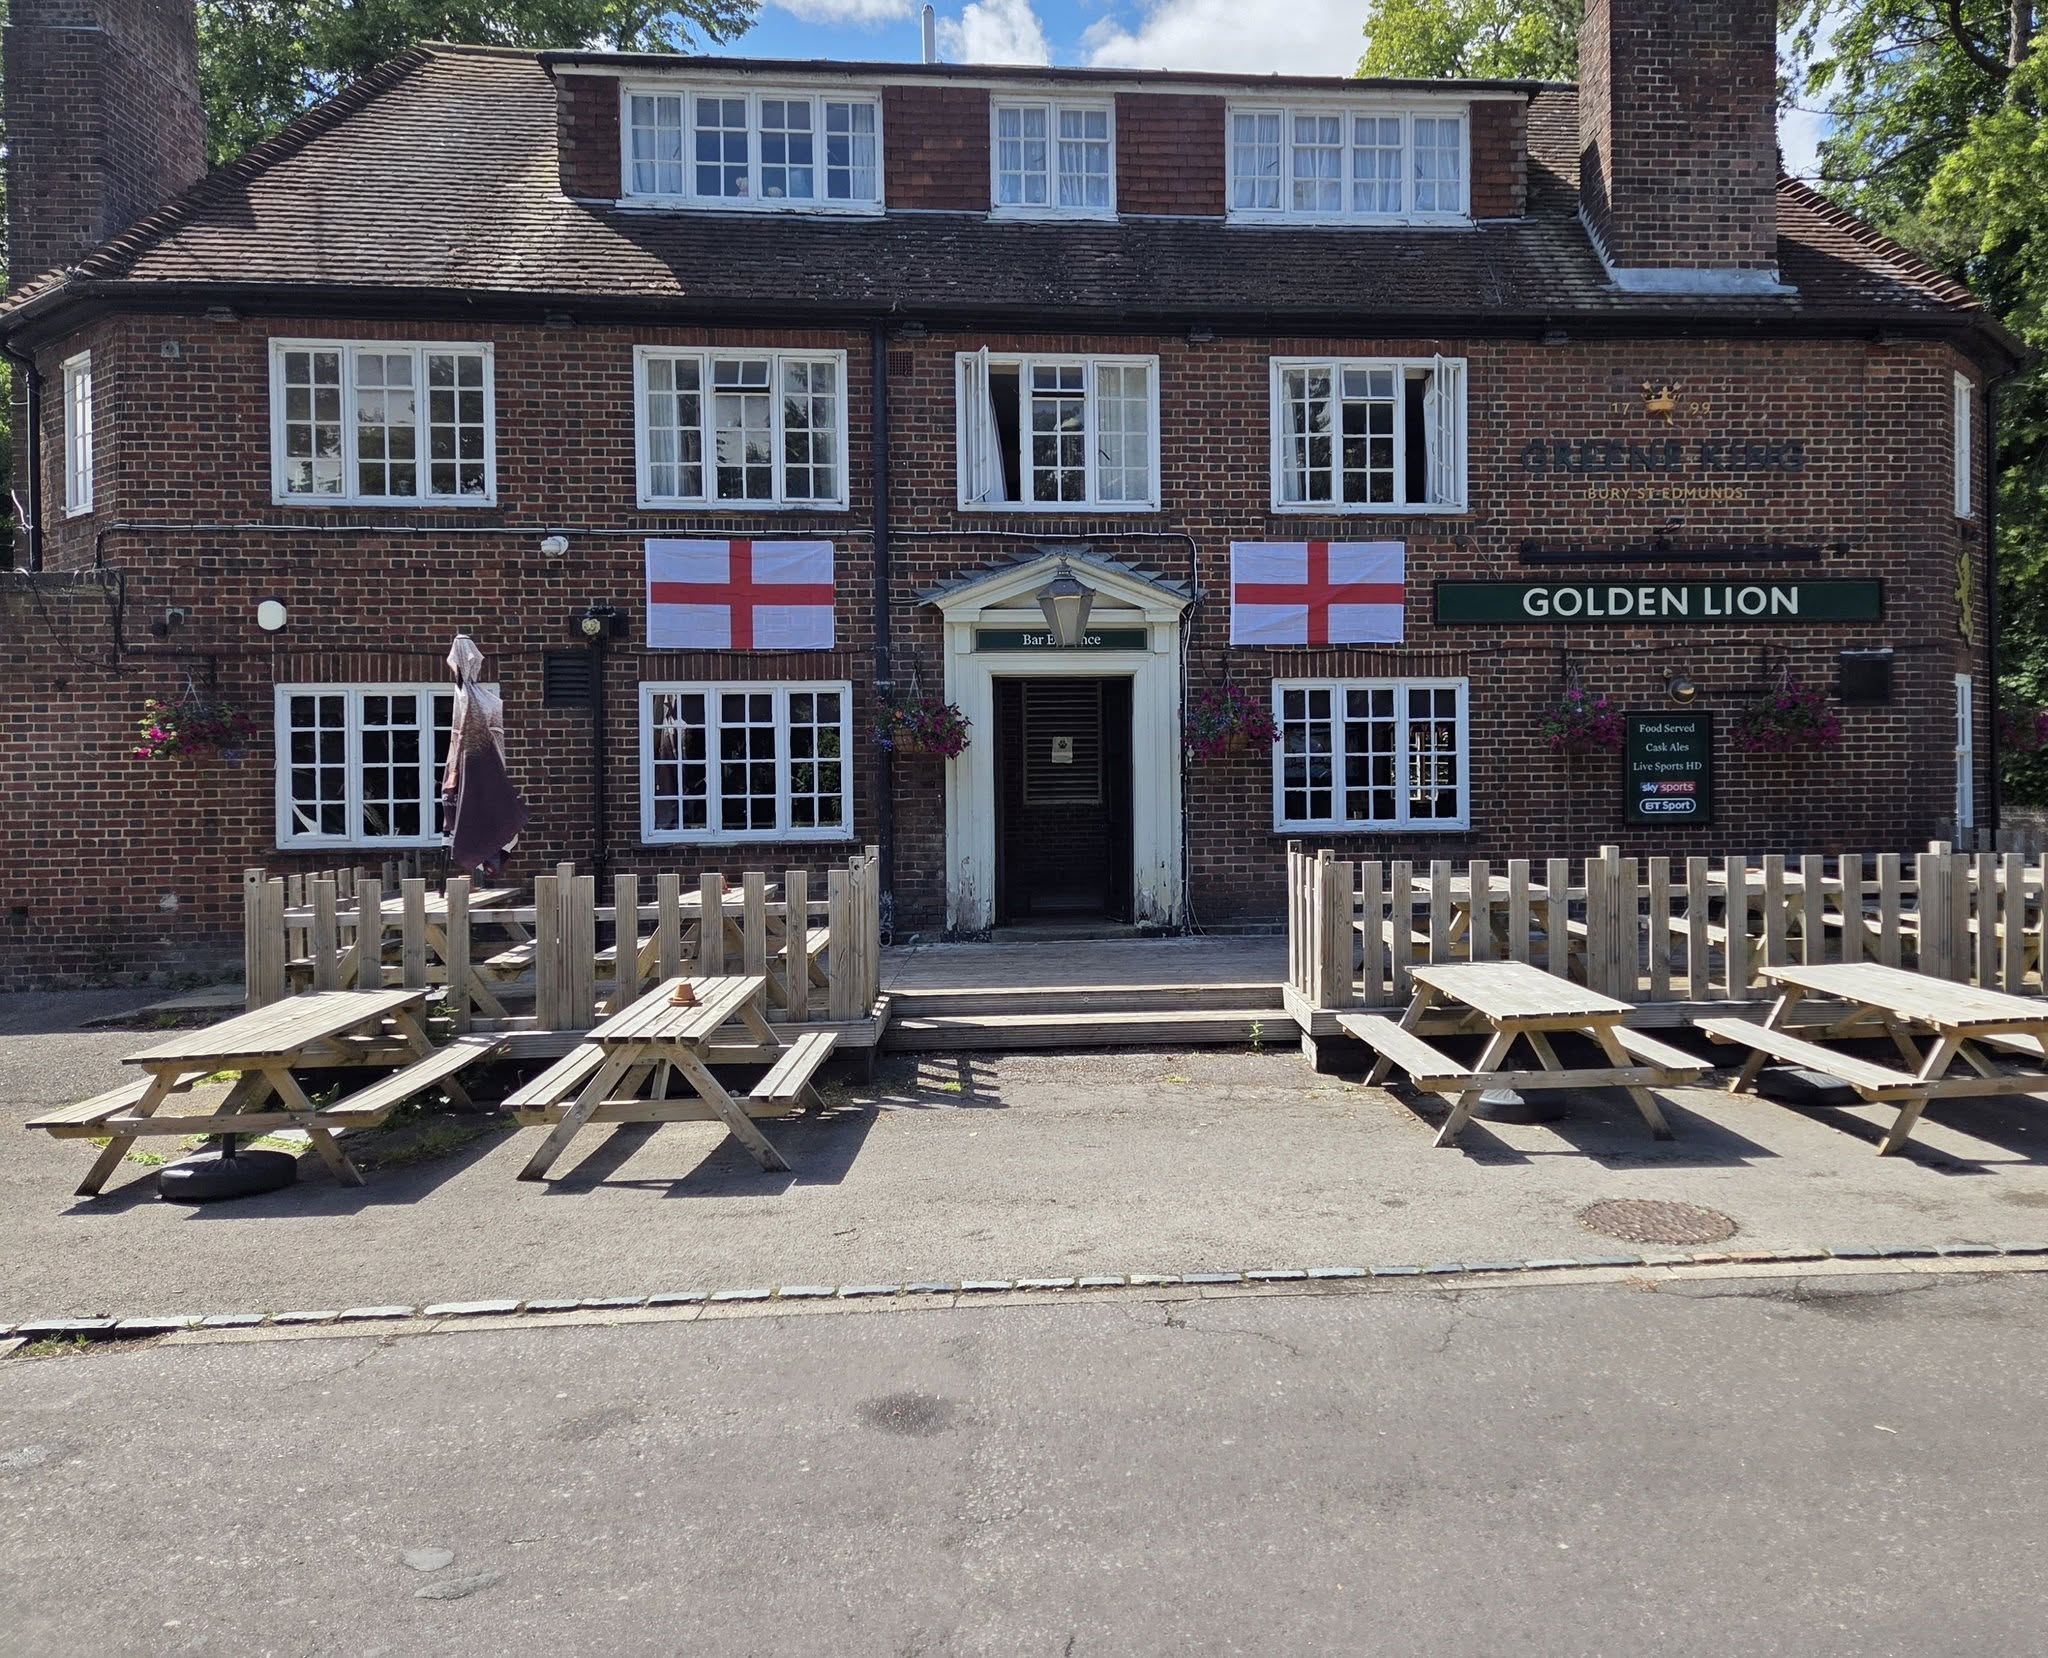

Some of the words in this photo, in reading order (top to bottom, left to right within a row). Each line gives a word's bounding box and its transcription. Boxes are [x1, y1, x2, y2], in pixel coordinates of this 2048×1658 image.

[1611, 402, 1631, 415] 17
[1689, 401, 1711, 415] 99
[1520, 438, 1684, 472] GREENE
[1701, 438, 1805, 472] KING
[1587, 487, 1631, 500] BURY
[1637, 487, 1655, 500] ST
[1662, 486, 1744, 500] EDMUNDS
[1522, 587, 1688, 616] GOLDEN
[1704, 586, 1799, 615] LION
[1023, 634, 1044, 645] Bar
[1047, 634, 1101, 645] Ence
[1639, 723, 1662, 733] Food
[1664, 723, 1695, 733] Served
[1645, 742, 1667, 751] Cask
[1669, 742, 1689, 751] Ales
[1633, 762, 1653, 771] Live
[1654, 762, 1684, 772] Sports
[1686, 762, 1702, 770] HD
[1641, 782, 1659, 793] sky
[1660, 782, 1694, 792] sports
[1645, 802, 1661, 810] BT
[1662, 801, 1691, 811] Sport
